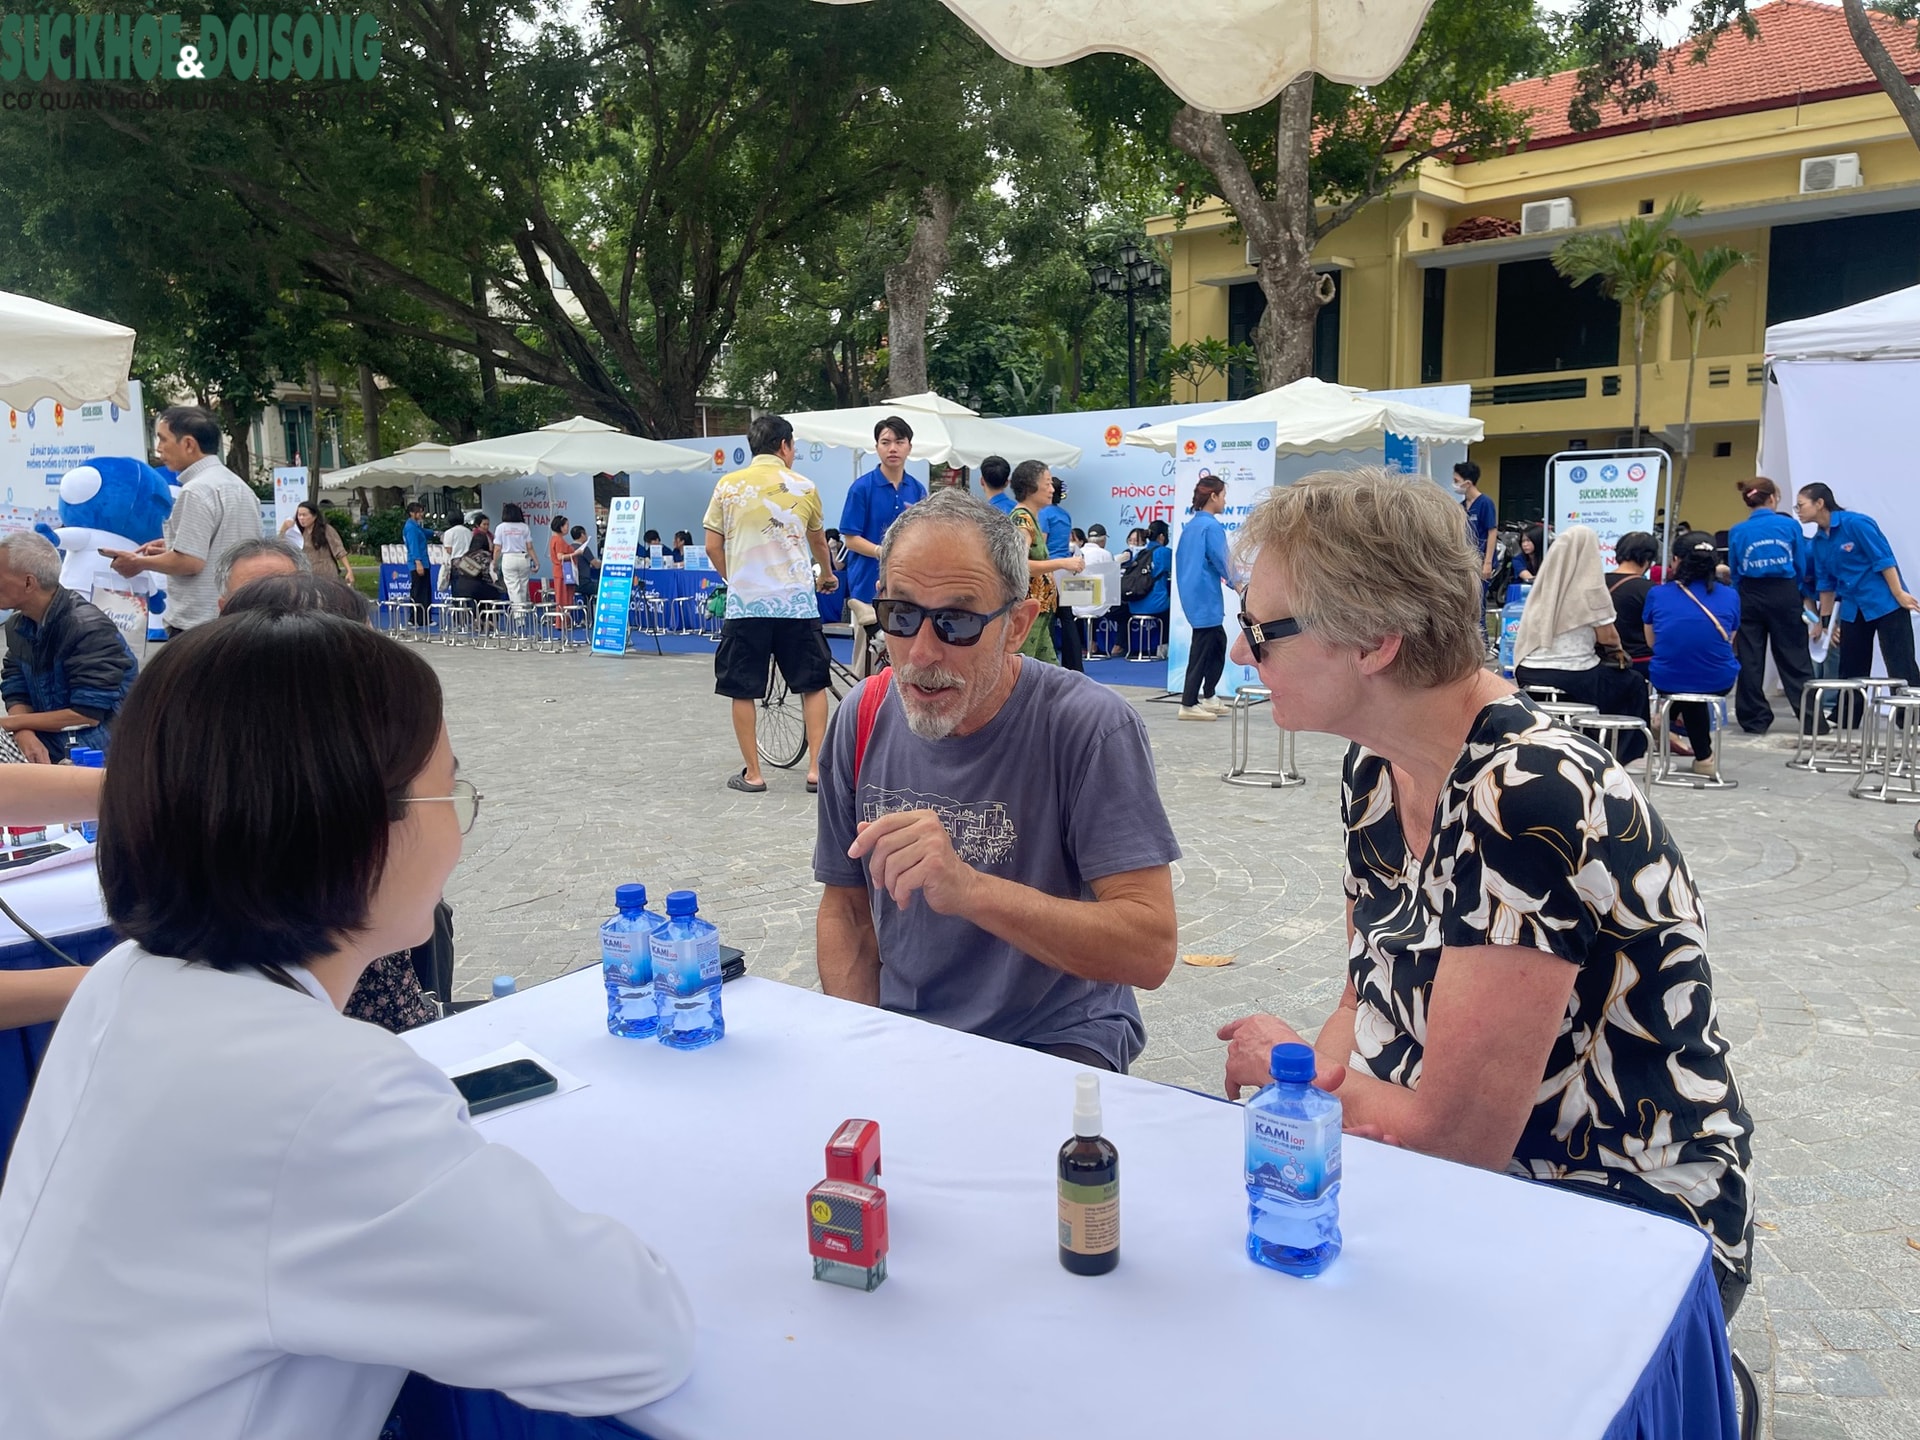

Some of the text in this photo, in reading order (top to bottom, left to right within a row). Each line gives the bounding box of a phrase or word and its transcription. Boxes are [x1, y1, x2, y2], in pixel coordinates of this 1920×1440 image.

[1111, 482, 1155, 499] PHÒNG
[1255, 1121, 1289, 1141] KAMI
[1290, 1134, 1306, 1146] ion
